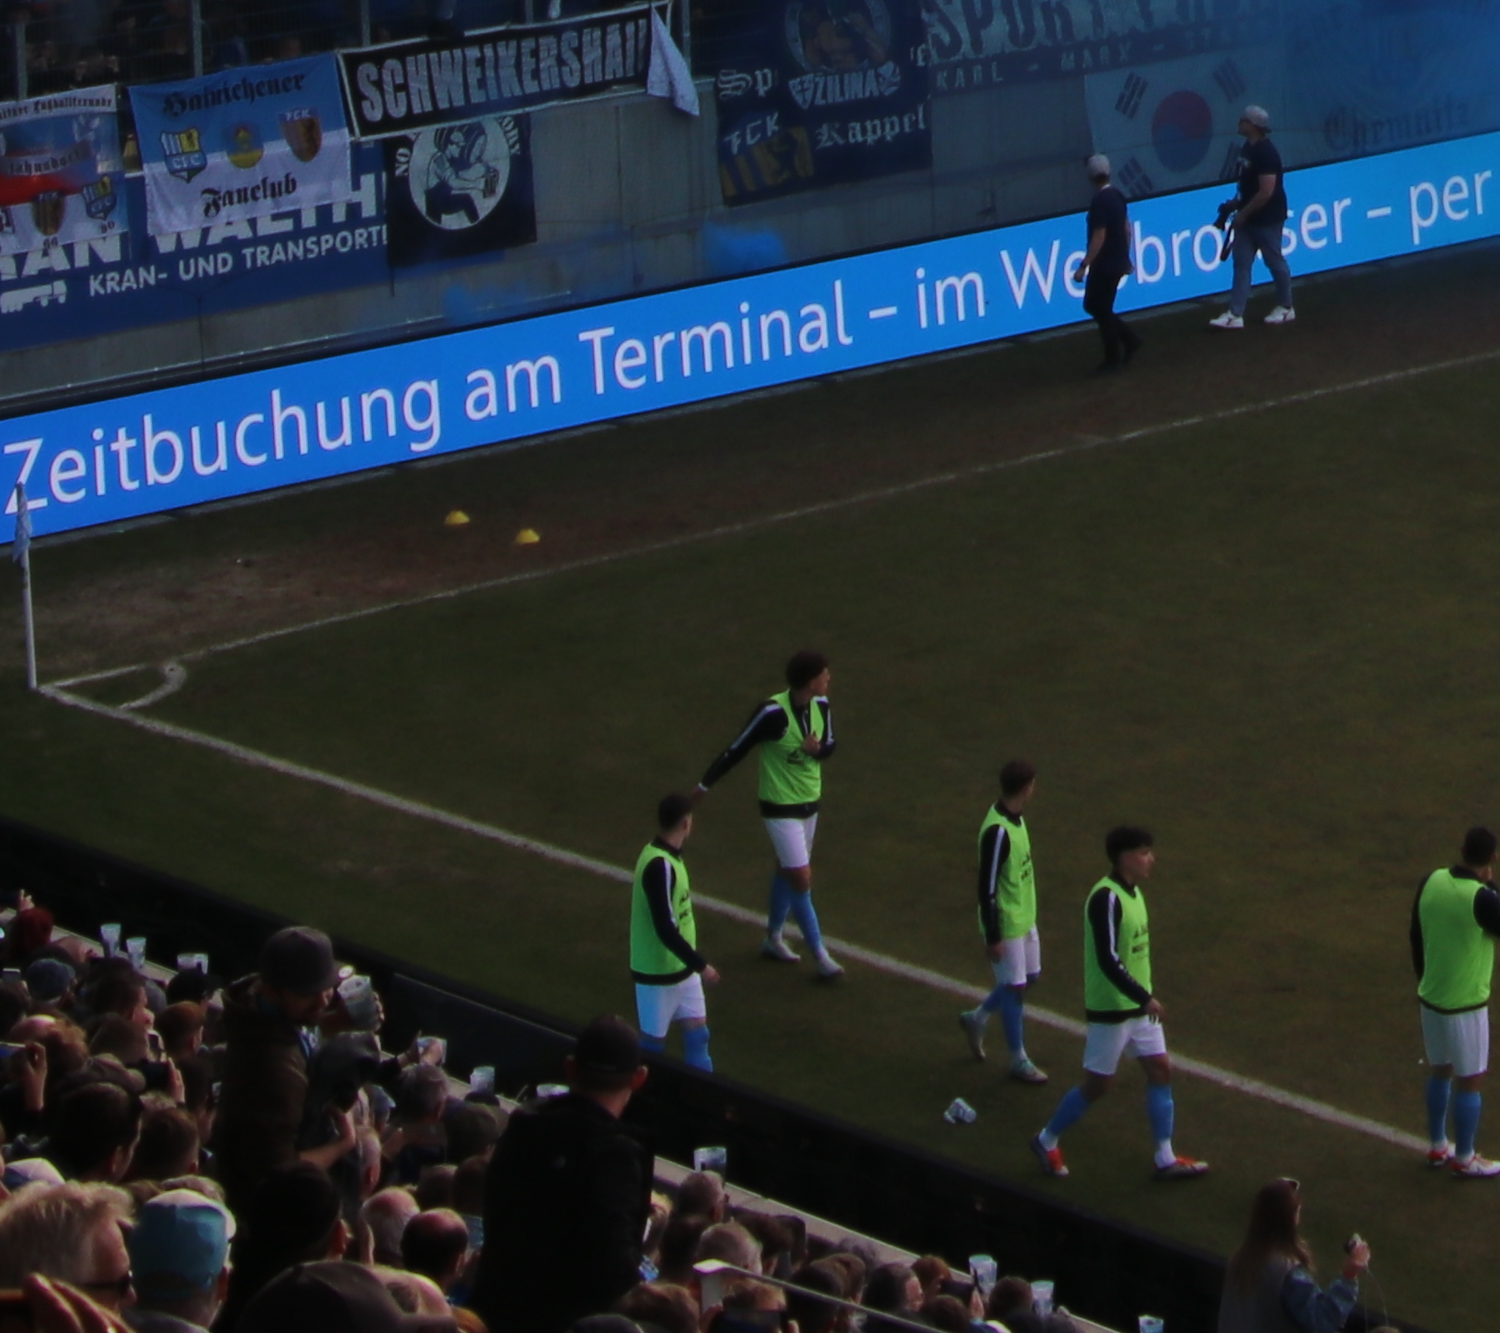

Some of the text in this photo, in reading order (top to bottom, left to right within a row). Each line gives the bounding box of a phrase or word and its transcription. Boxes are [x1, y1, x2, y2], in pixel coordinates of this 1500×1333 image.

[815, 103, 927, 151] Kappel
[201, 172, 298, 218] Fanclub
[88, 268, 167, 297] KRAN-
[178, 252, 233, 283] UND
[3, 383, 441, 516] Zeitbuchung
[464, 353, 561, 419] am
[578, 280, 852, 397] Terminal
[914, 257, 988, 330] im
[999, 196, 1352, 310] Webroser
[1409, 173, 1491, 245] per
